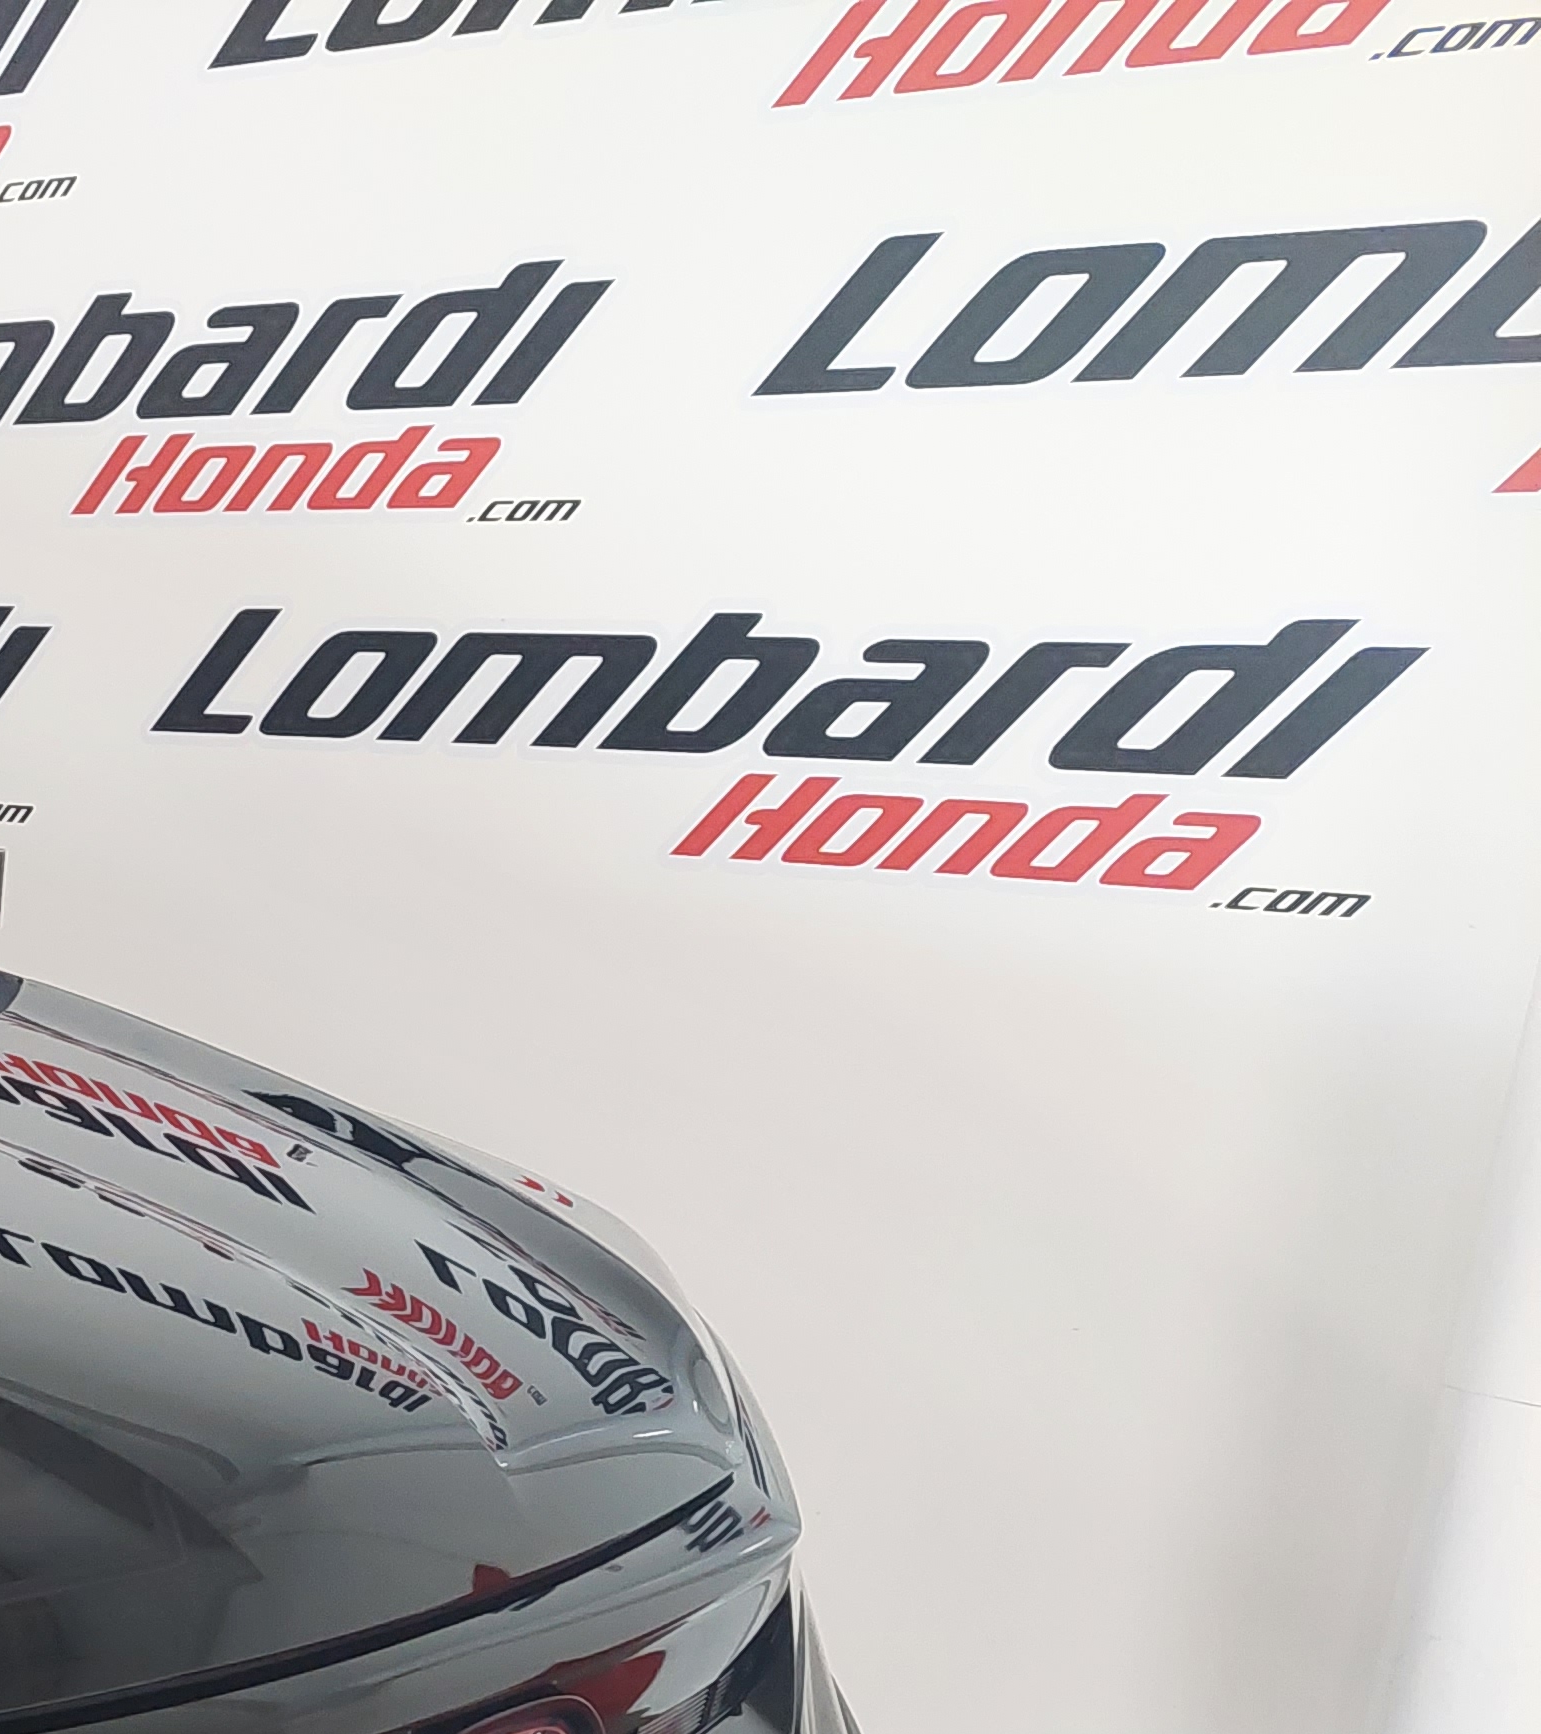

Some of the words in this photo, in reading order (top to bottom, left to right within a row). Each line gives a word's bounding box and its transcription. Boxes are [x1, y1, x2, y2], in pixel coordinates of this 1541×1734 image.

[72, 426, 501, 515] Honda
[465, 499, 582, 523] .com
[150, 609, 1429, 779] Lombardi
[672, 774, 1261, 890] Honda
[1208, 886, 1372, 918] .com
